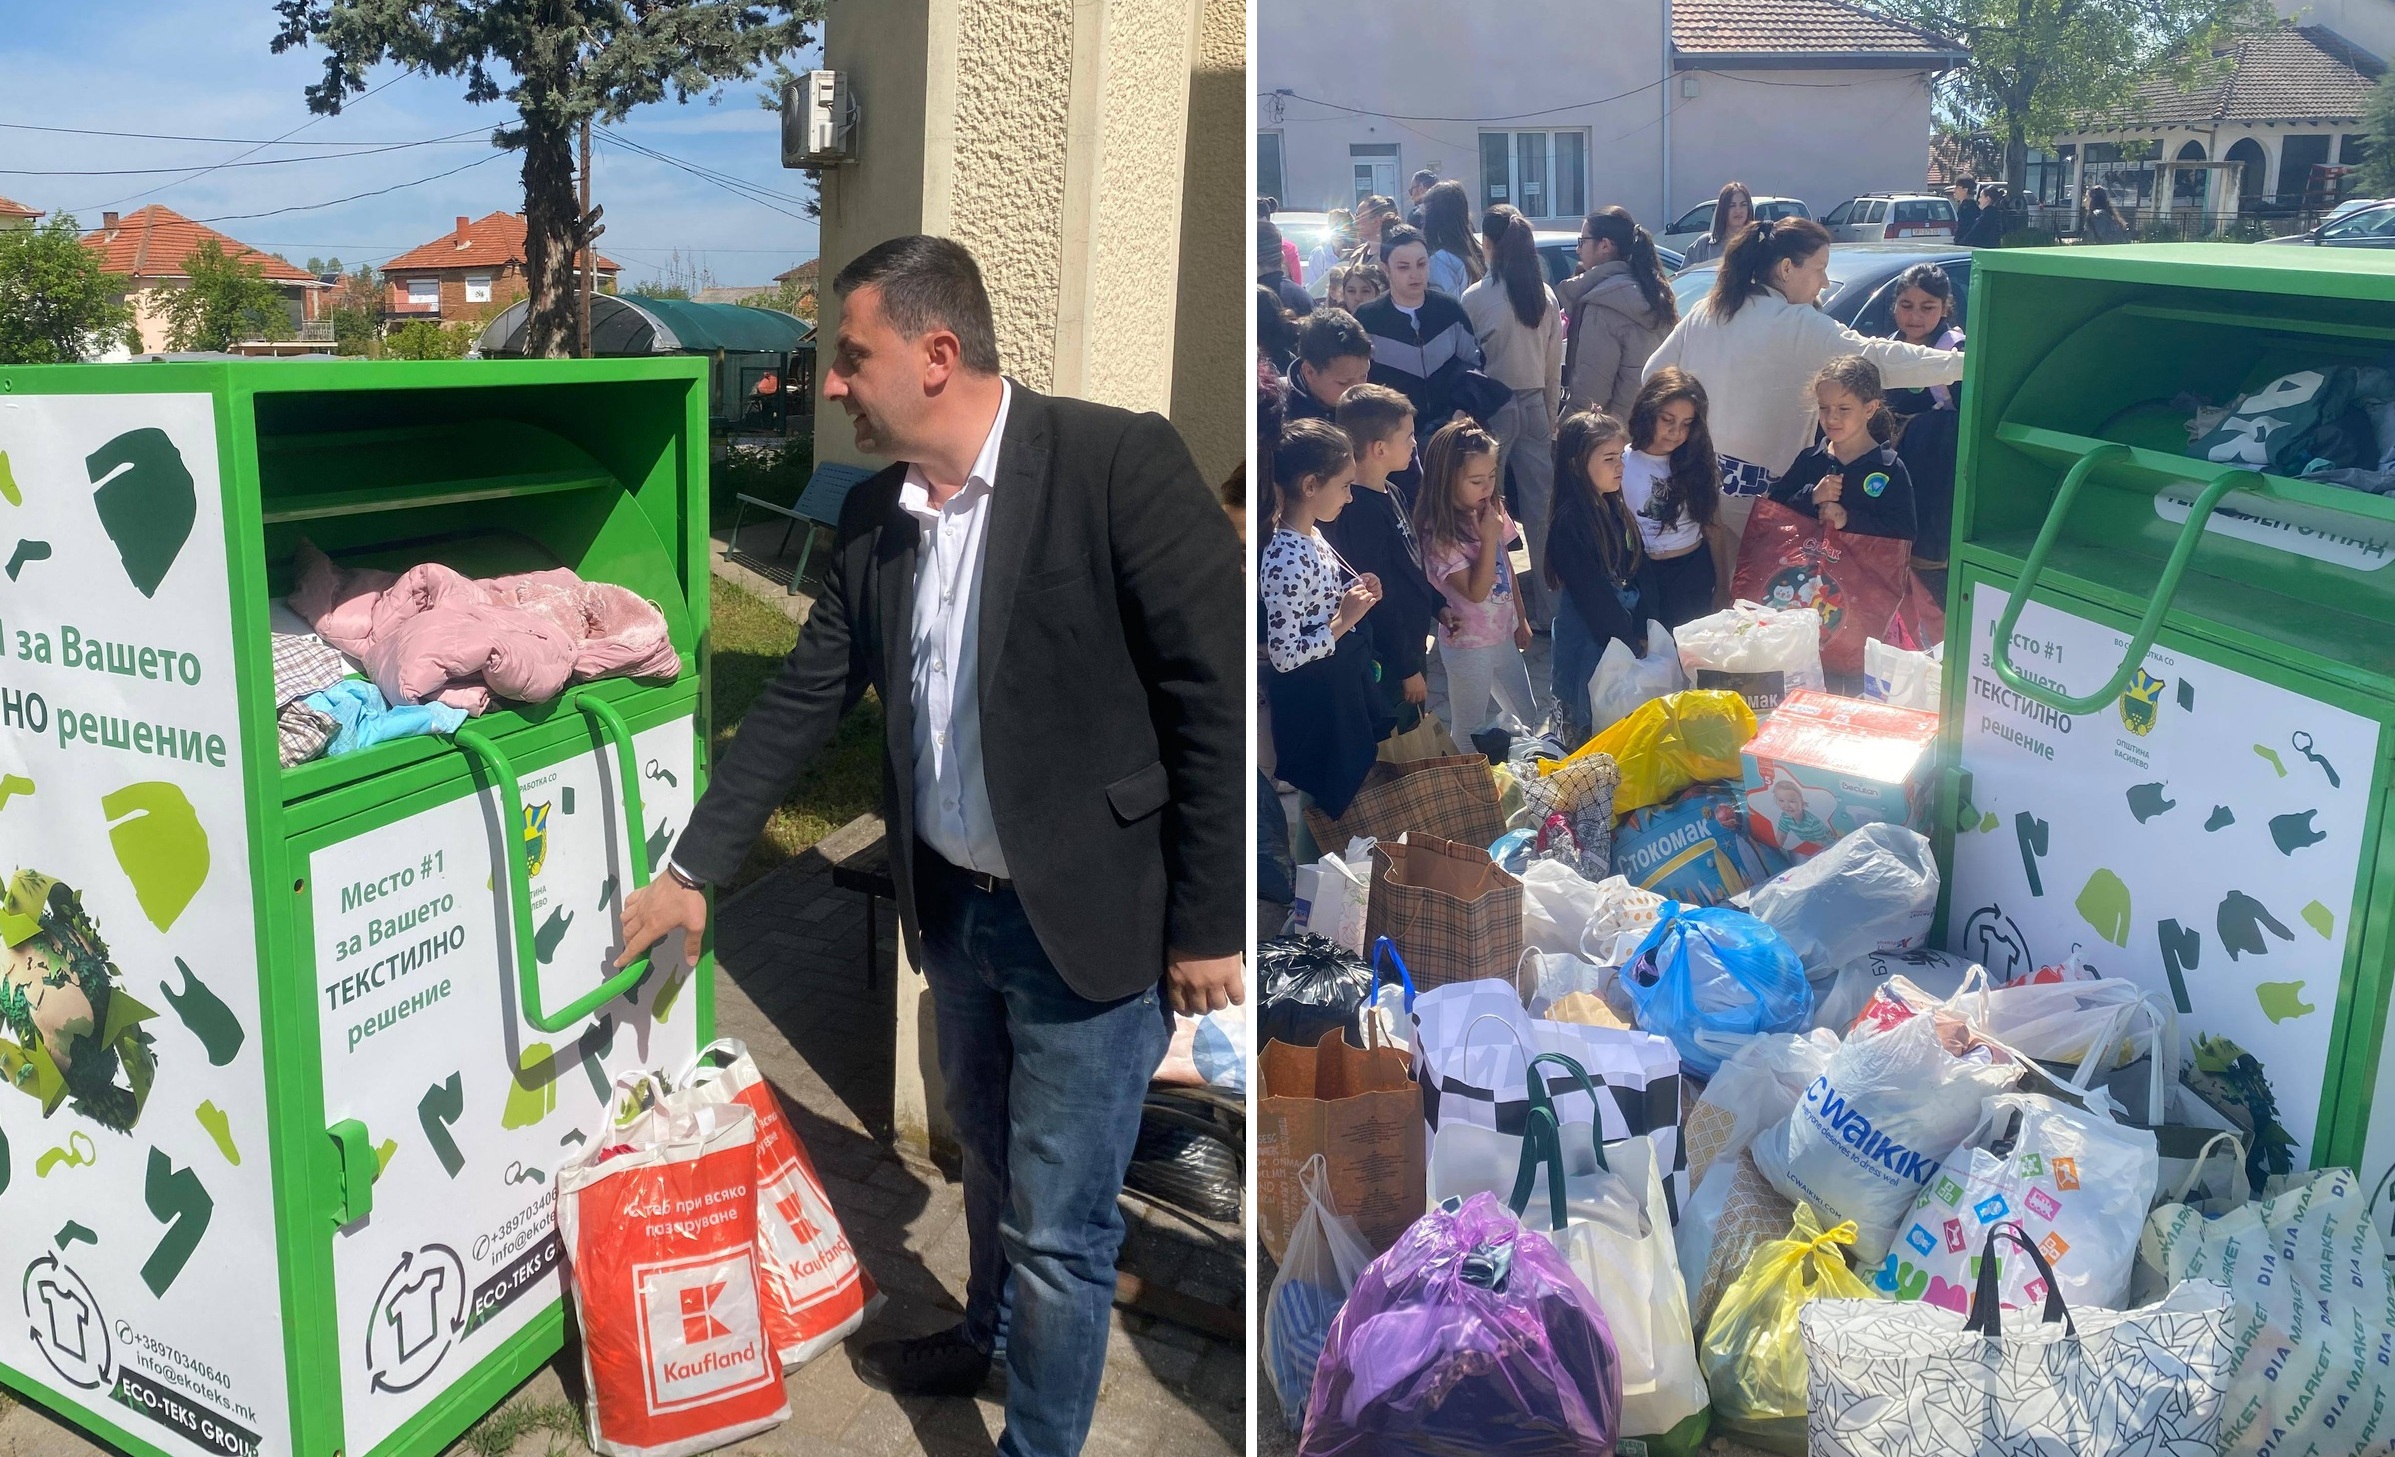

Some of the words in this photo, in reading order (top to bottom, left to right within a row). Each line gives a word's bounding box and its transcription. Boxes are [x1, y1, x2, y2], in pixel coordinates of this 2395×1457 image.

[16, 630, 51, 664] за
[61, 625, 201, 686] Вашето
[2044, 641, 2063, 664] #1
[1972, 676, 2072, 734] ТЕКСТИЛНО
[57, 708, 226, 768] решение
[1981, 715, 2055, 762] решение
[2114, 749, 2149, 770] ВАСИЛЕВО
[2116, 738, 2150, 760] ОПШТИНА
[341, 867, 414, 914] Место
[421, 849, 444, 880] #1
[335, 936, 362, 962] за
[368, 893, 454, 947] Вашето
[326, 925, 465, 1011] ТЕКСТИЛНО
[348, 979, 451, 1053] решение
[1821, 1128, 1851, 1157] deserves
[1851, 1152, 1860, 1163] to
[1860, 1160, 1881, 1178] dress
[1883, 1174, 1900, 1186] well
[676, 1197, 702, 1215] при
[704, 1185, 746, 1206] всяко
[1786, 1171, 1842, 1219] LCWAIKIKI.COM
[2258, 1254, 2275, 1286] DIA
[2284, 1228, 2298, 1261] DIA
[2319, 1212, 2338, 1293] MARKET
[475, 1254, 541, 1316] ECO-TEKS
[2350, 1258, 2363, 1288] DIA
[2319, 1300, 2332, 1326] DIA
[135, 1333, 231, 1389] +38970340640
[664, 1343, 755, 1383] Kaufland
[2264, 1347, 2291, 1382] DIA
[2323, 1394, 2349, 1429] DIA
[2346, 1306, 2366, 1392] MARKET
[2378, 1333, 2391, 1366] DIA
[122, 1378, 197, 1431] ECO-TEKS
[137, 1351, 257, 1424] info@ekoteks.mk
[2286, 1340, 2332, 1427] MARKET
